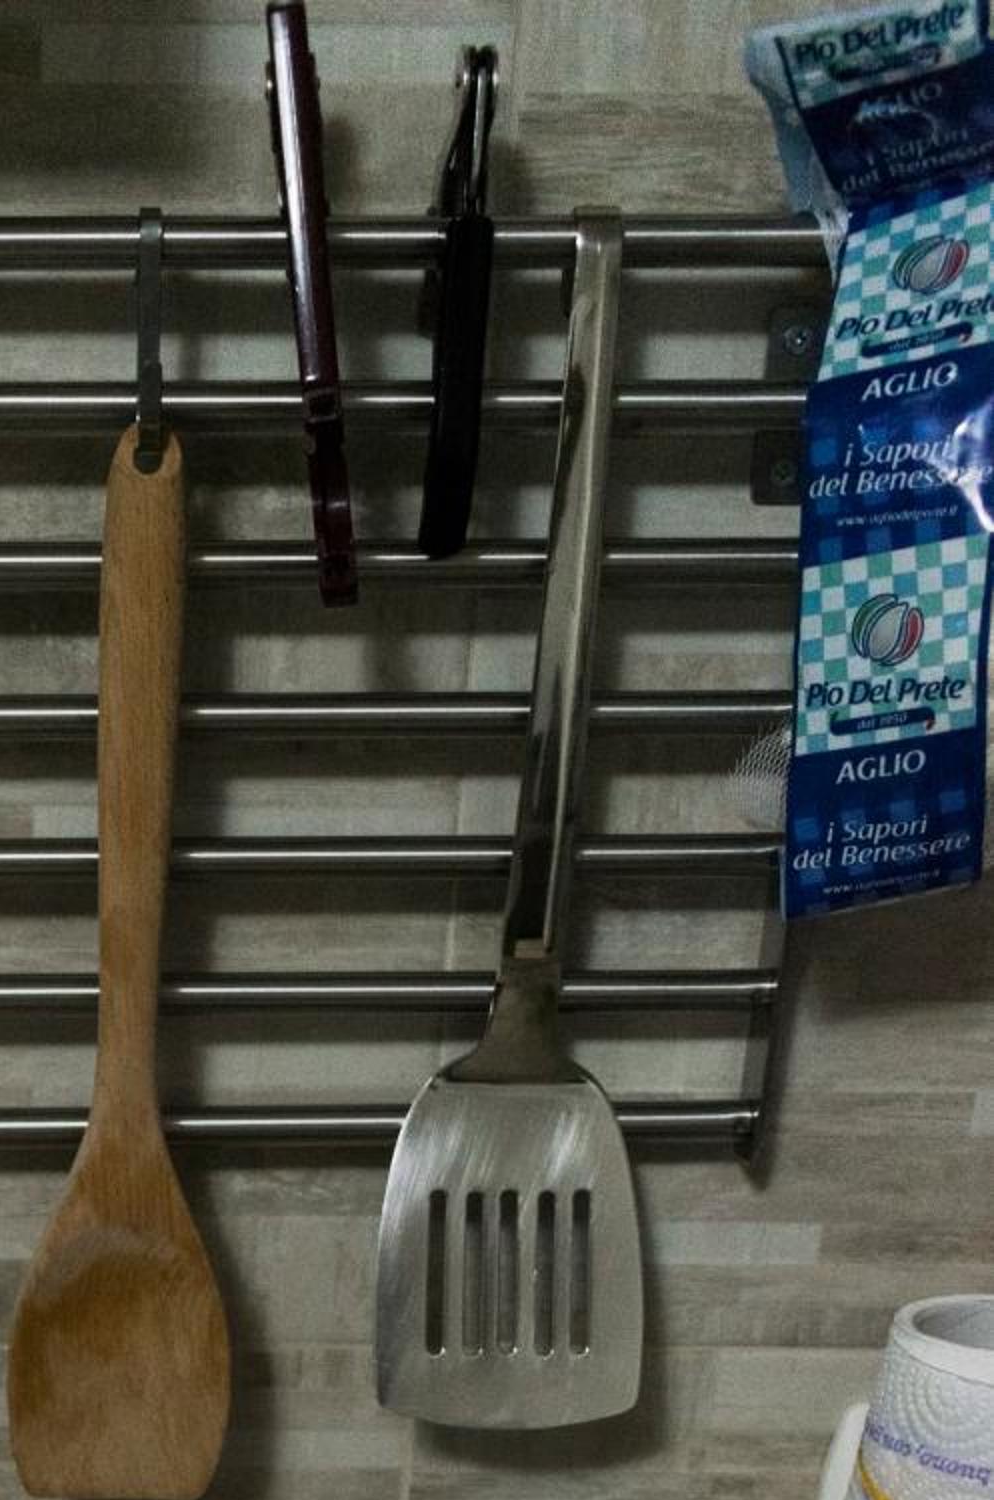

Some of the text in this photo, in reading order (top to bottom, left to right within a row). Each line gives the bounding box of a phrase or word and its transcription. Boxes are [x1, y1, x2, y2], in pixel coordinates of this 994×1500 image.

[795, 41, 837, 62] Pio
[843, 24, 886, 51] Del
[895, 3, 965, 44] Prete
[836, 317, 879, 339] Pio
[885, 305, 931, 331] Del
[861, 362, 958, 402] AGLIO
[845, 434, 957, 471] i Sapori
[809, 473, 848, 499] del
[806, 677, 966, 707] Pio Del Prete
[836, 749, 926, 784] AGLIO
[827, 814, 927, 846] i Sapori
[793, 834, 970, 870] del Benessere
